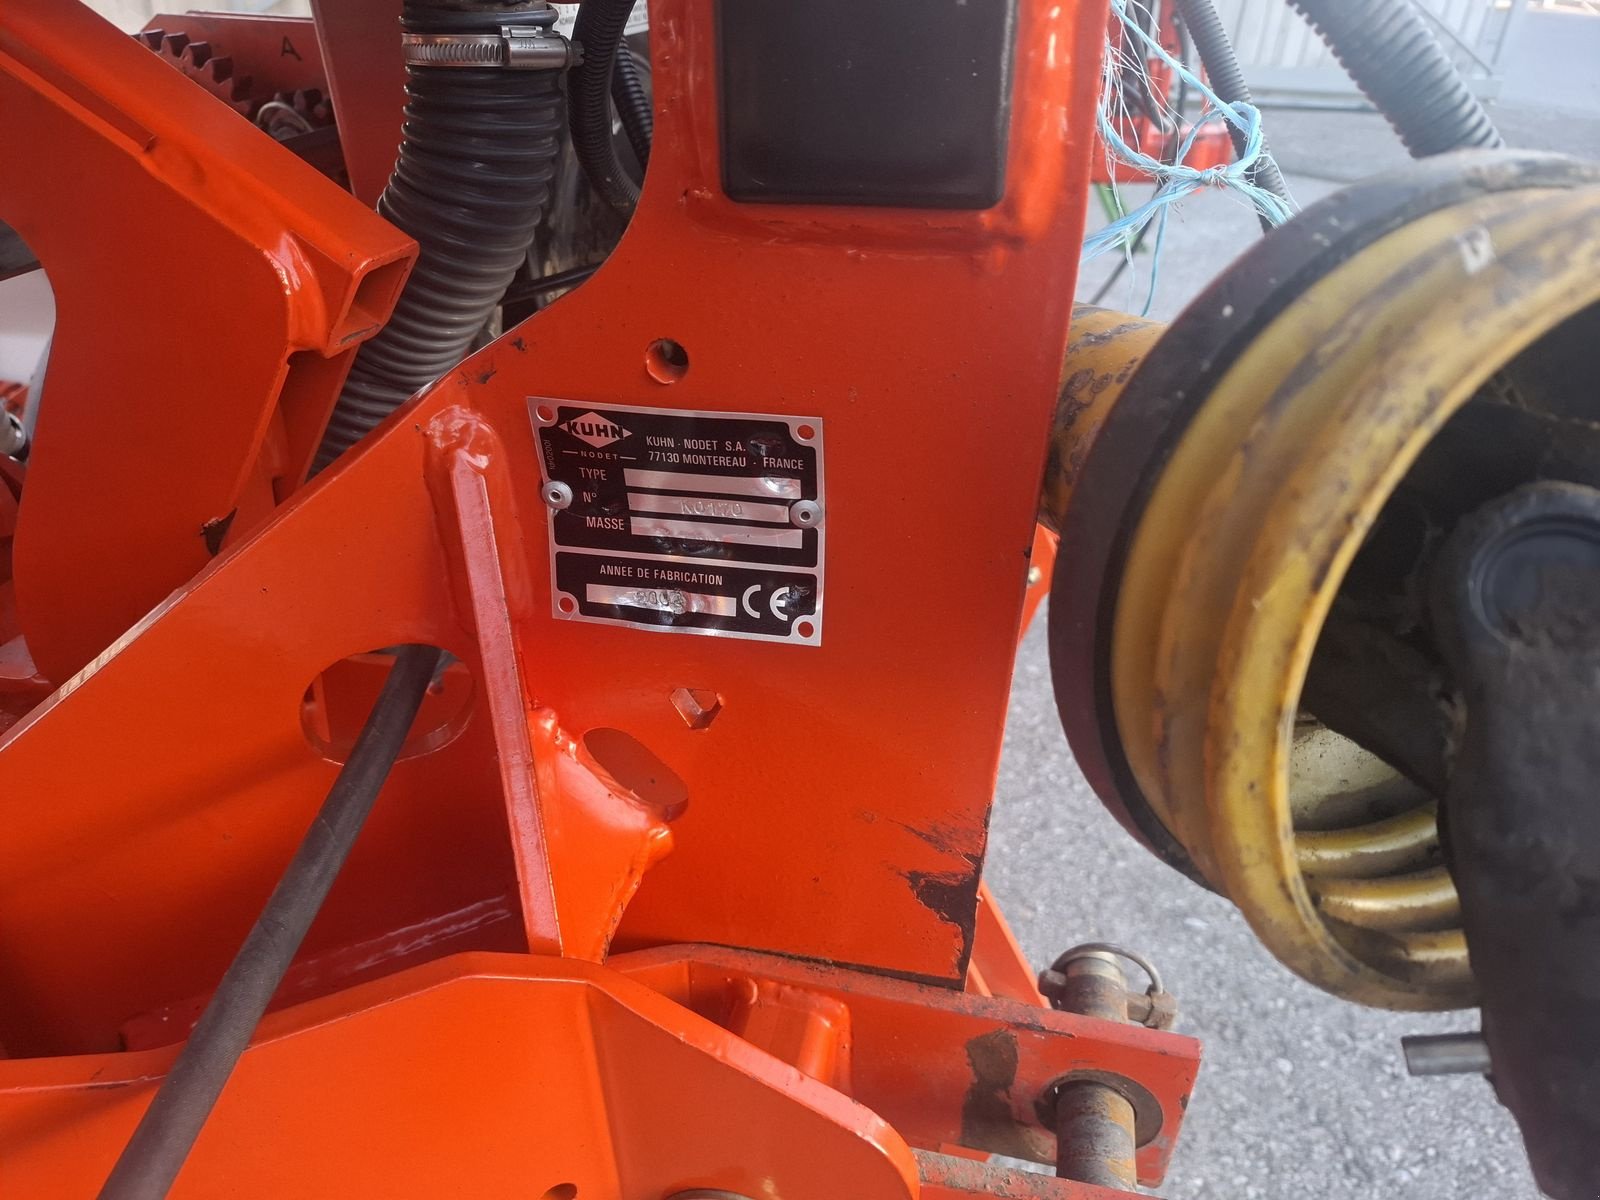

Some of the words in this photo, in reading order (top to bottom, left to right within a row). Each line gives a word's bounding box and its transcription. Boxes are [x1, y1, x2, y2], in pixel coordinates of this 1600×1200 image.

[281, 35, 303, 61] A
[565, 421, 625, 440] KUHN
[646, 435, 675, 448] KUHN
[683, 438, 718, 451] NODET
[725, 441, 746, 452] S.A.
[580, 450, 618, 460] NODET
[648, 451, 680, 463] 77130
[682, 453, 746, 467] MONTEREAU
[763, 457, 804, 470] FRANCE
[578, 467, 607, 481] TYPE
[582, 491, 597, 503] N°
[586, 516, 625, 531] MASSE
[637, 567, 650, 579] DE
[654, 569, 723, 586] FABRICATION
[742, 584, 790, 622] CE
